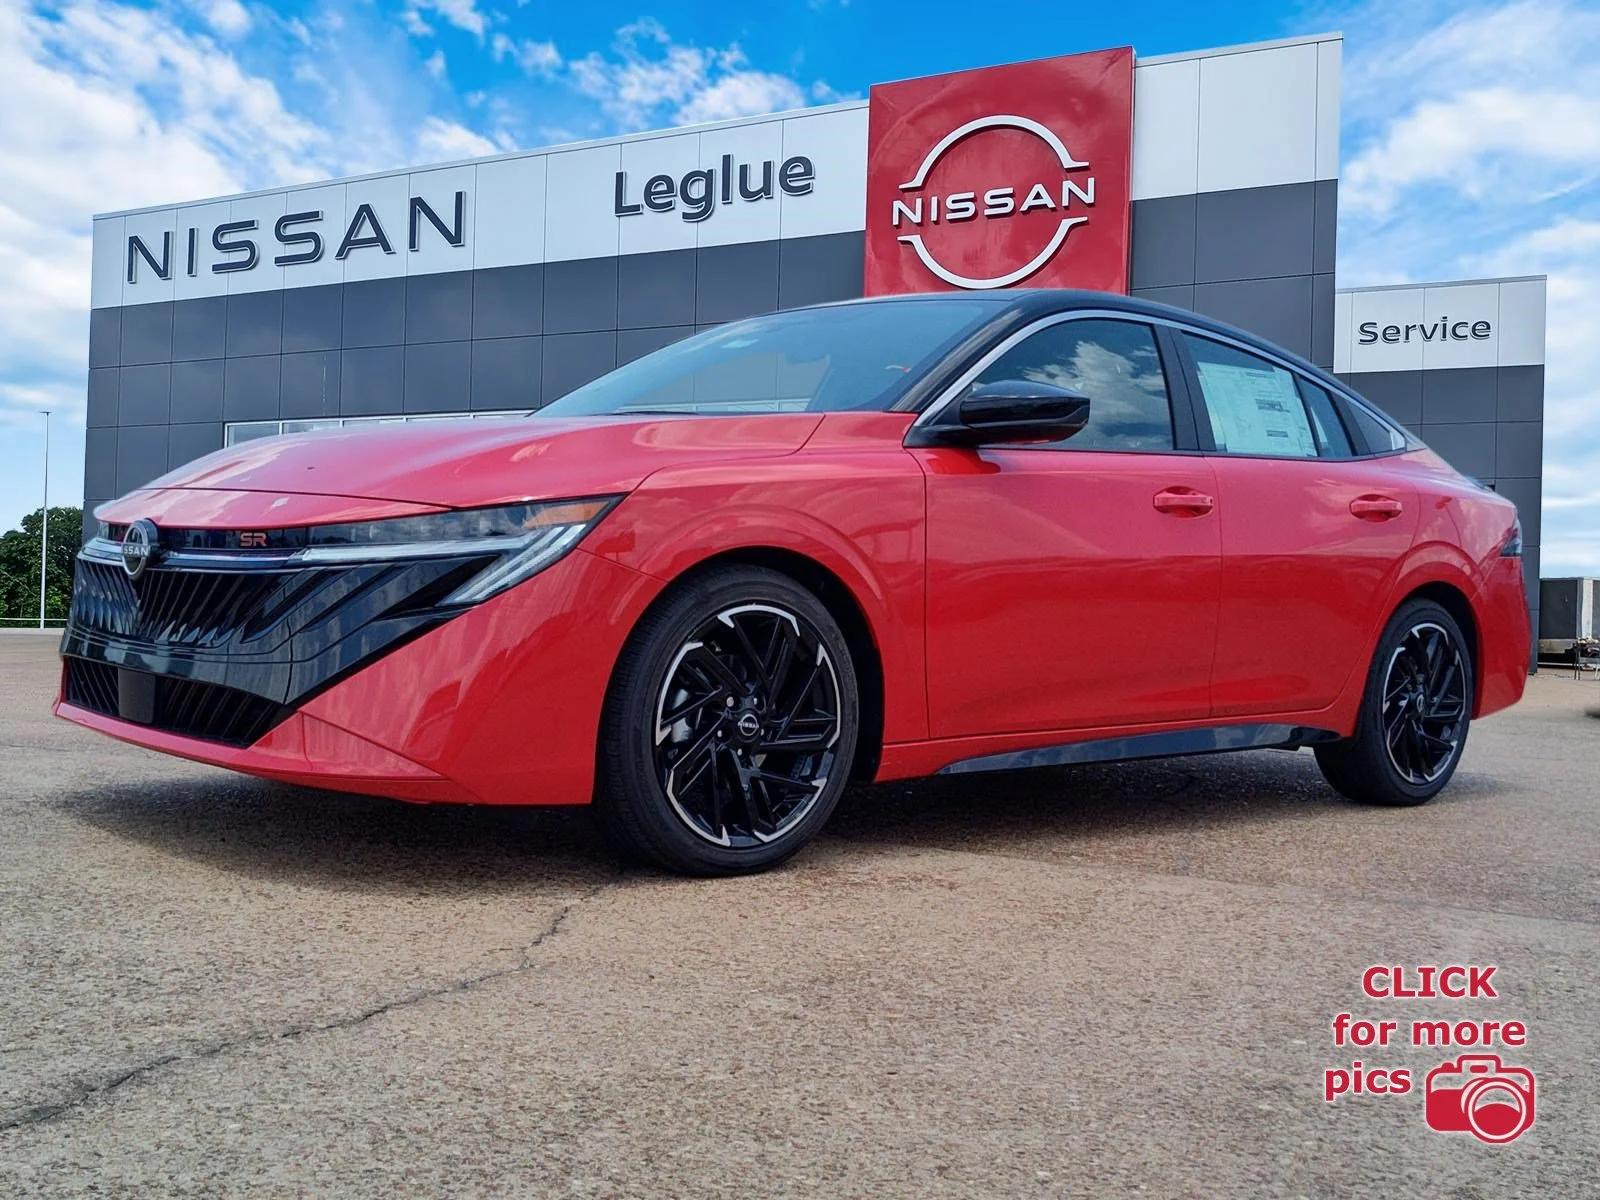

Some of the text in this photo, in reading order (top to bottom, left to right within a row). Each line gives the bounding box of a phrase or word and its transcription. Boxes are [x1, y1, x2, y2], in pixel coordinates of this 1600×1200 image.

[614, 153, 815, 222] Leglue
[892, 177, 1095, 226] NISSAN
[127, 190, 466, 284] NISSAN
[1358, 316, 1491, 345] Service
[240, 532, 267, 547] SR
